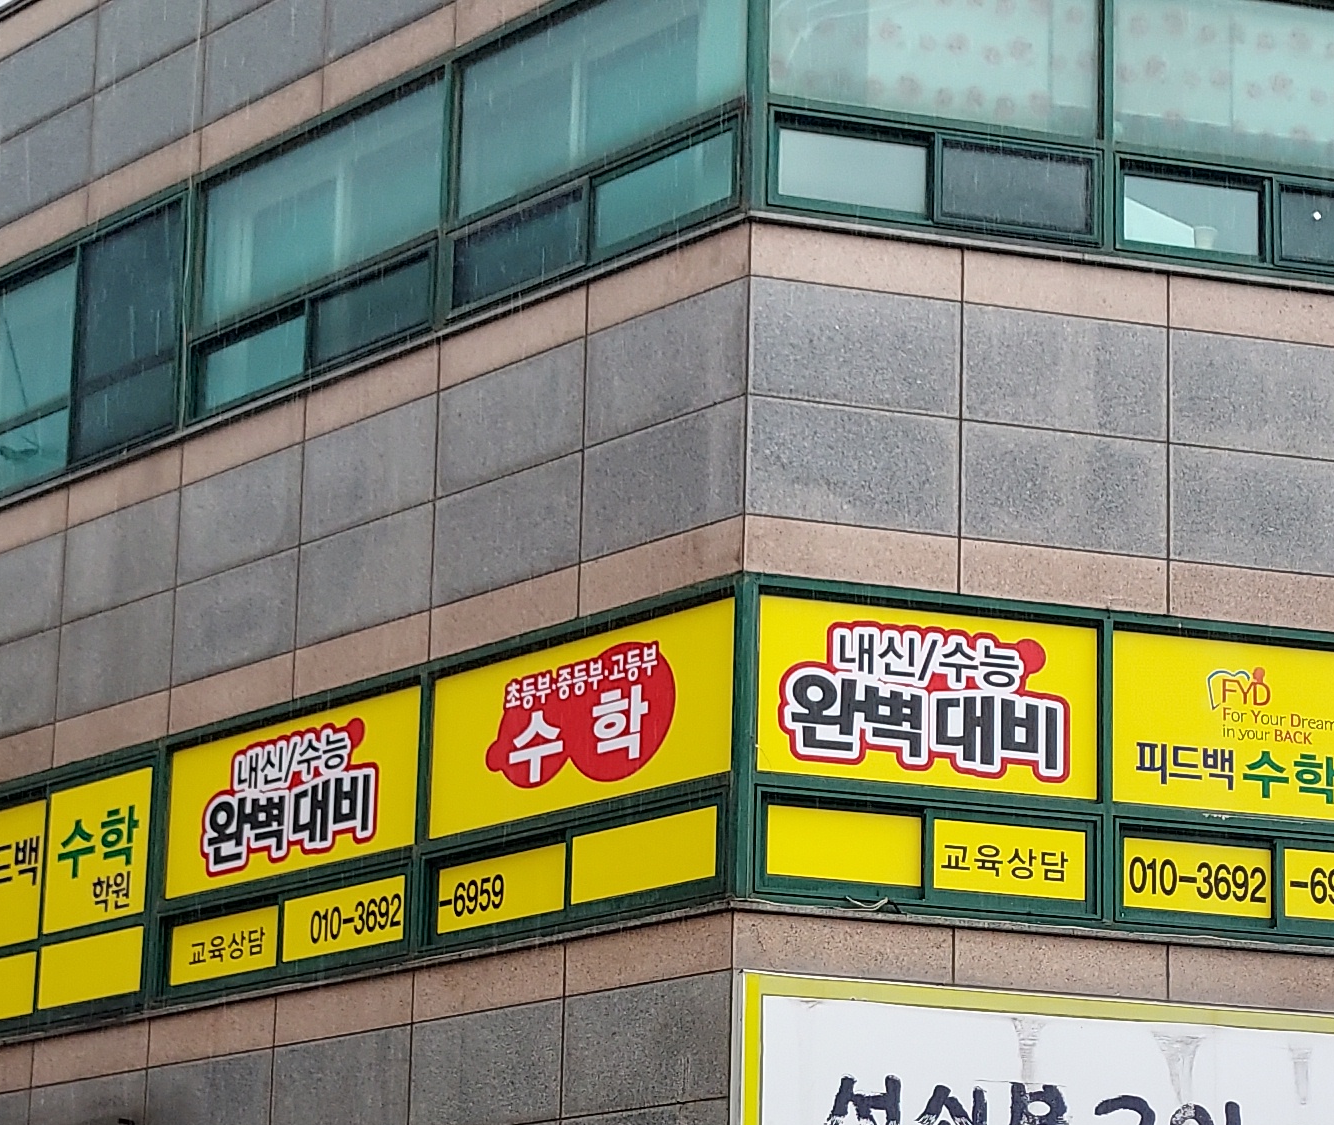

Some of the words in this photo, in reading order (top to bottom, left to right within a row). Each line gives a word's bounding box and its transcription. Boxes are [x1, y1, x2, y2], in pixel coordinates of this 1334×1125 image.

[838, 634, 1022, 687] 내신/수능
[1222, 679, 1271, 706] FYD
[1223, 707, 1247, 722] For
[1251, 710, 1286, 727] Your
[790, 675, 922, 758] 완벽
[936, 695, 1058, 771] 대비
[1223, 724, 1235, 738] in
[1238, 728, 1270, 741] your
[1275, 729, 1312, 745] BACK
[236, 728, 348, 790] 내신/수능
[1136, 741, 1235, 791] 피드백
[57, 804, 140, 878] 수학
[207, 791, 286, 864] 완벽
[292, 772, 371, 849] 대비
[941, 843, 1069, 882] 교육상담
[1129, 855, 1267, 904] 010-3692
[92, 870, 131, 912] 학원
[310, 893, 402, 945] 010-3692
[189, 925, 266, 966] 교육상담
